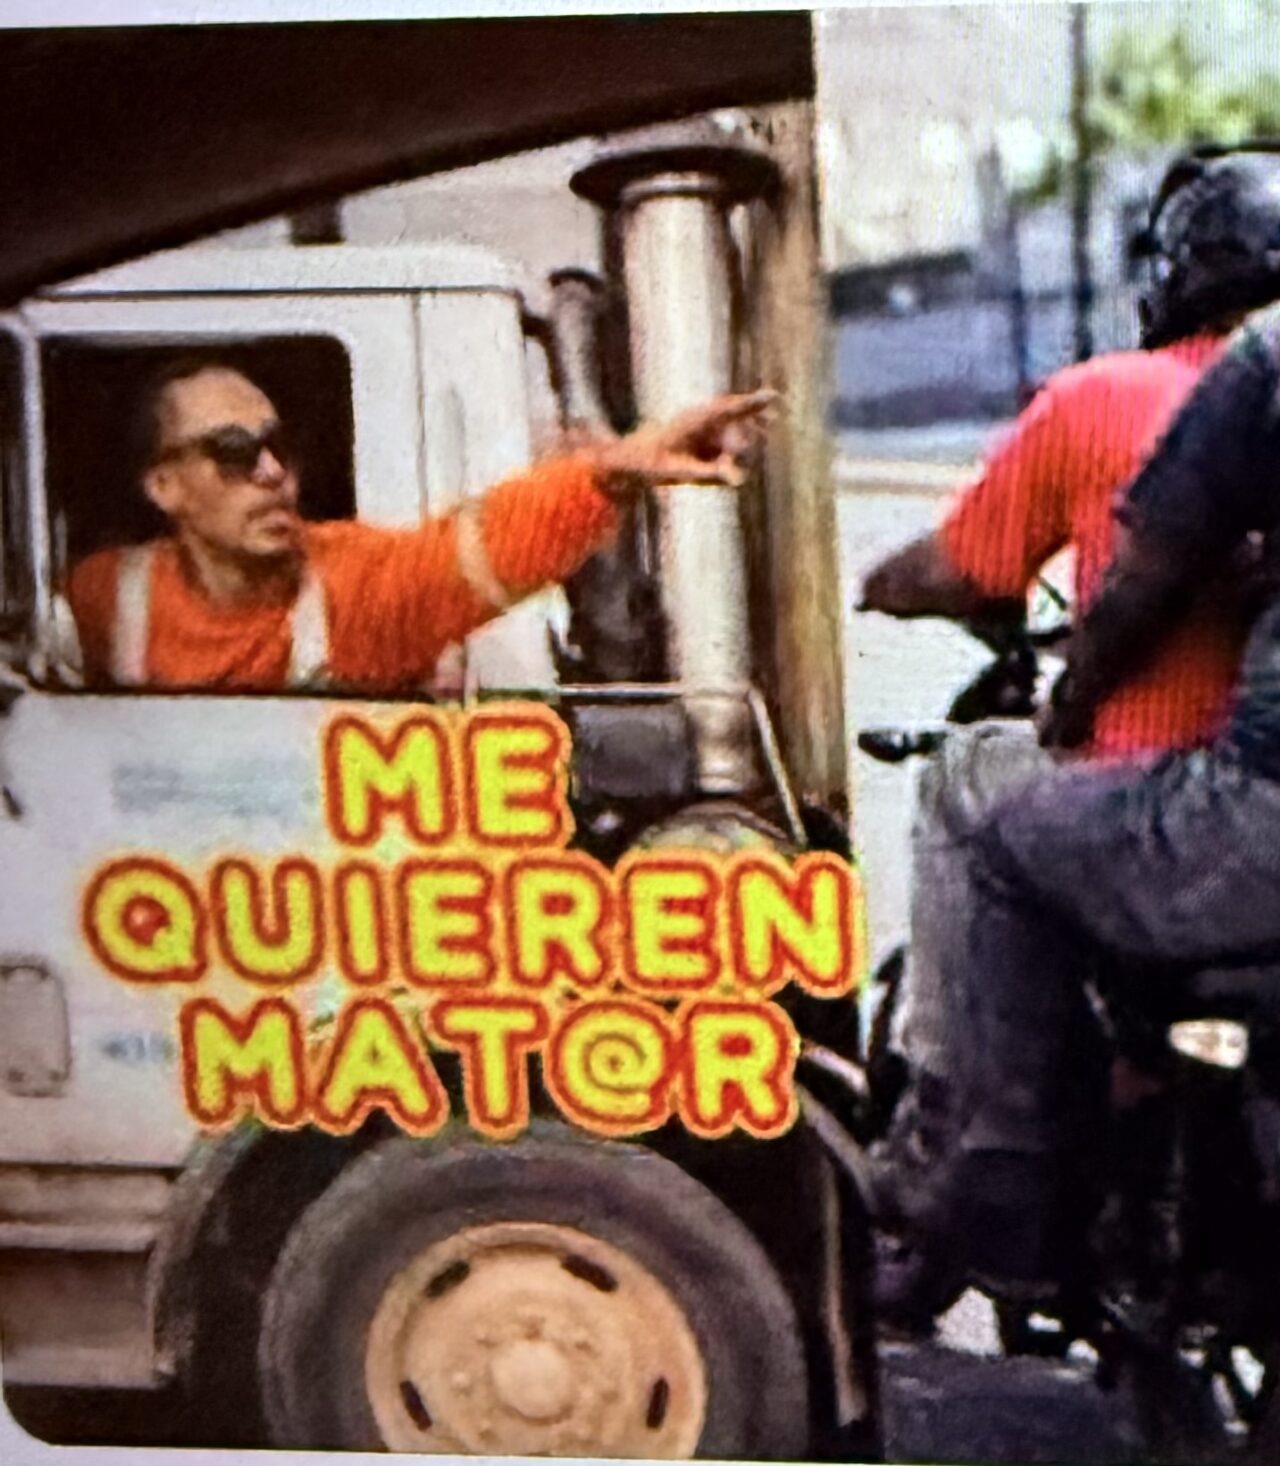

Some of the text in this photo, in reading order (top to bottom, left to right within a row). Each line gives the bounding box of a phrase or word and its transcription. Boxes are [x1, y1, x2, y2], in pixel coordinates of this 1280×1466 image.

[326, 713, 565, 847] ME
[84, 856, 858, 993] QUIEREN
[181, 998, 798, 1135] MAT@R
